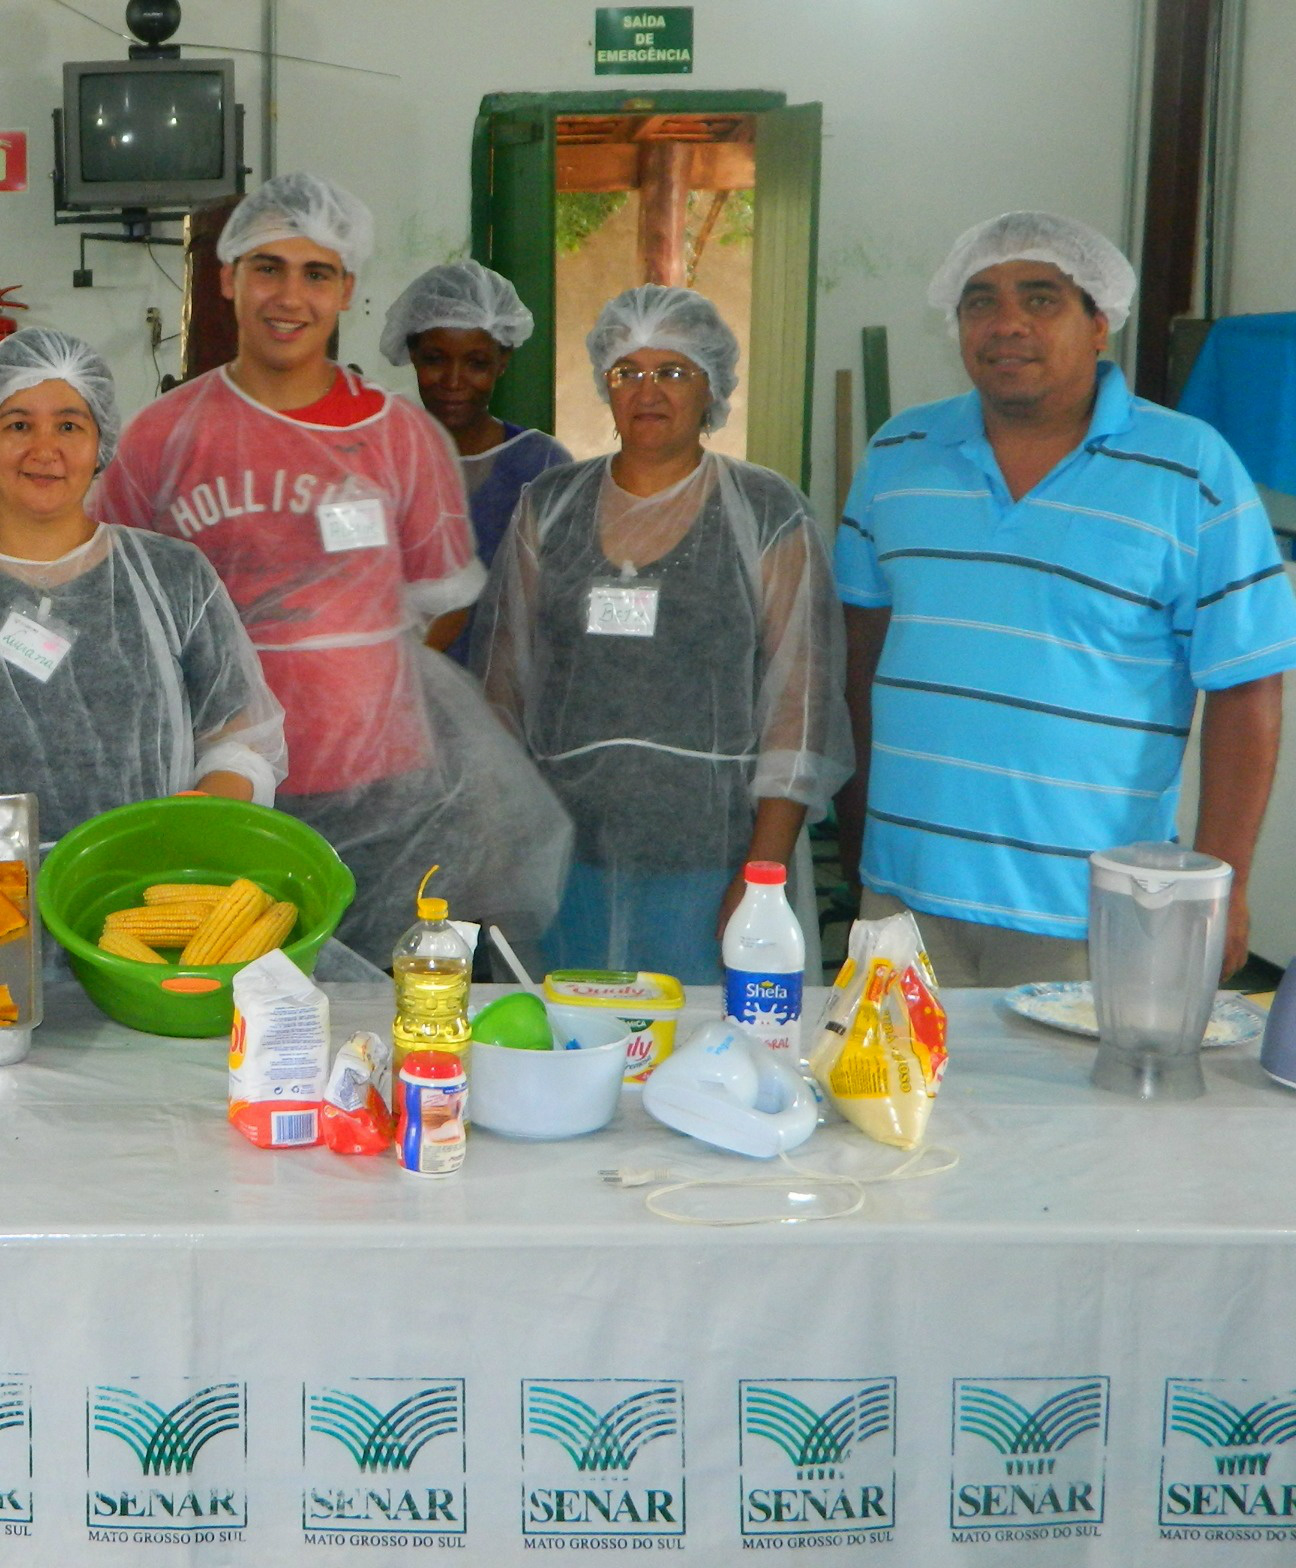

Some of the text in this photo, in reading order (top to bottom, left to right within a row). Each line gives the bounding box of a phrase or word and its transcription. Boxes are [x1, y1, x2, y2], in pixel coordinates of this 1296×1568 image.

[624, 13, 665, 28] SAÍDA
[635, 33, 654, 45] DE
[597, 47, 690, 62] EMERGÊNCIA
[746, 982, 787, 999] Shefa
[94, 1487, 239, 1517] SENAR
[310, 1488, 458, 1522] SENAR
[529, 1488, 677, 1523] SENAR
[748, 1485, 887, 1523] SENAR
[957, 1480, 1095, 1517] SENAR
[5, 1525, 32, 1537] SUL
[88, 1531, 246, 1544] MATO GROSSO DO SUL
[951, 1526, 1102, 1543] MATO GROSSO DO SUL
[1160, 1529, 1200, 1540] MATO
[1205, 1529, 1262, 1541] GROSSO
[1266, 1530, 1286, 1541] DO
[304, 1533, 466, 1548] MATO GROSSO DO SUL
[524, 1537, 685, 1550] MATO GROSSO DO SUL
[742, 1531, 894, 1549] MATO GROSSO DO SUL
